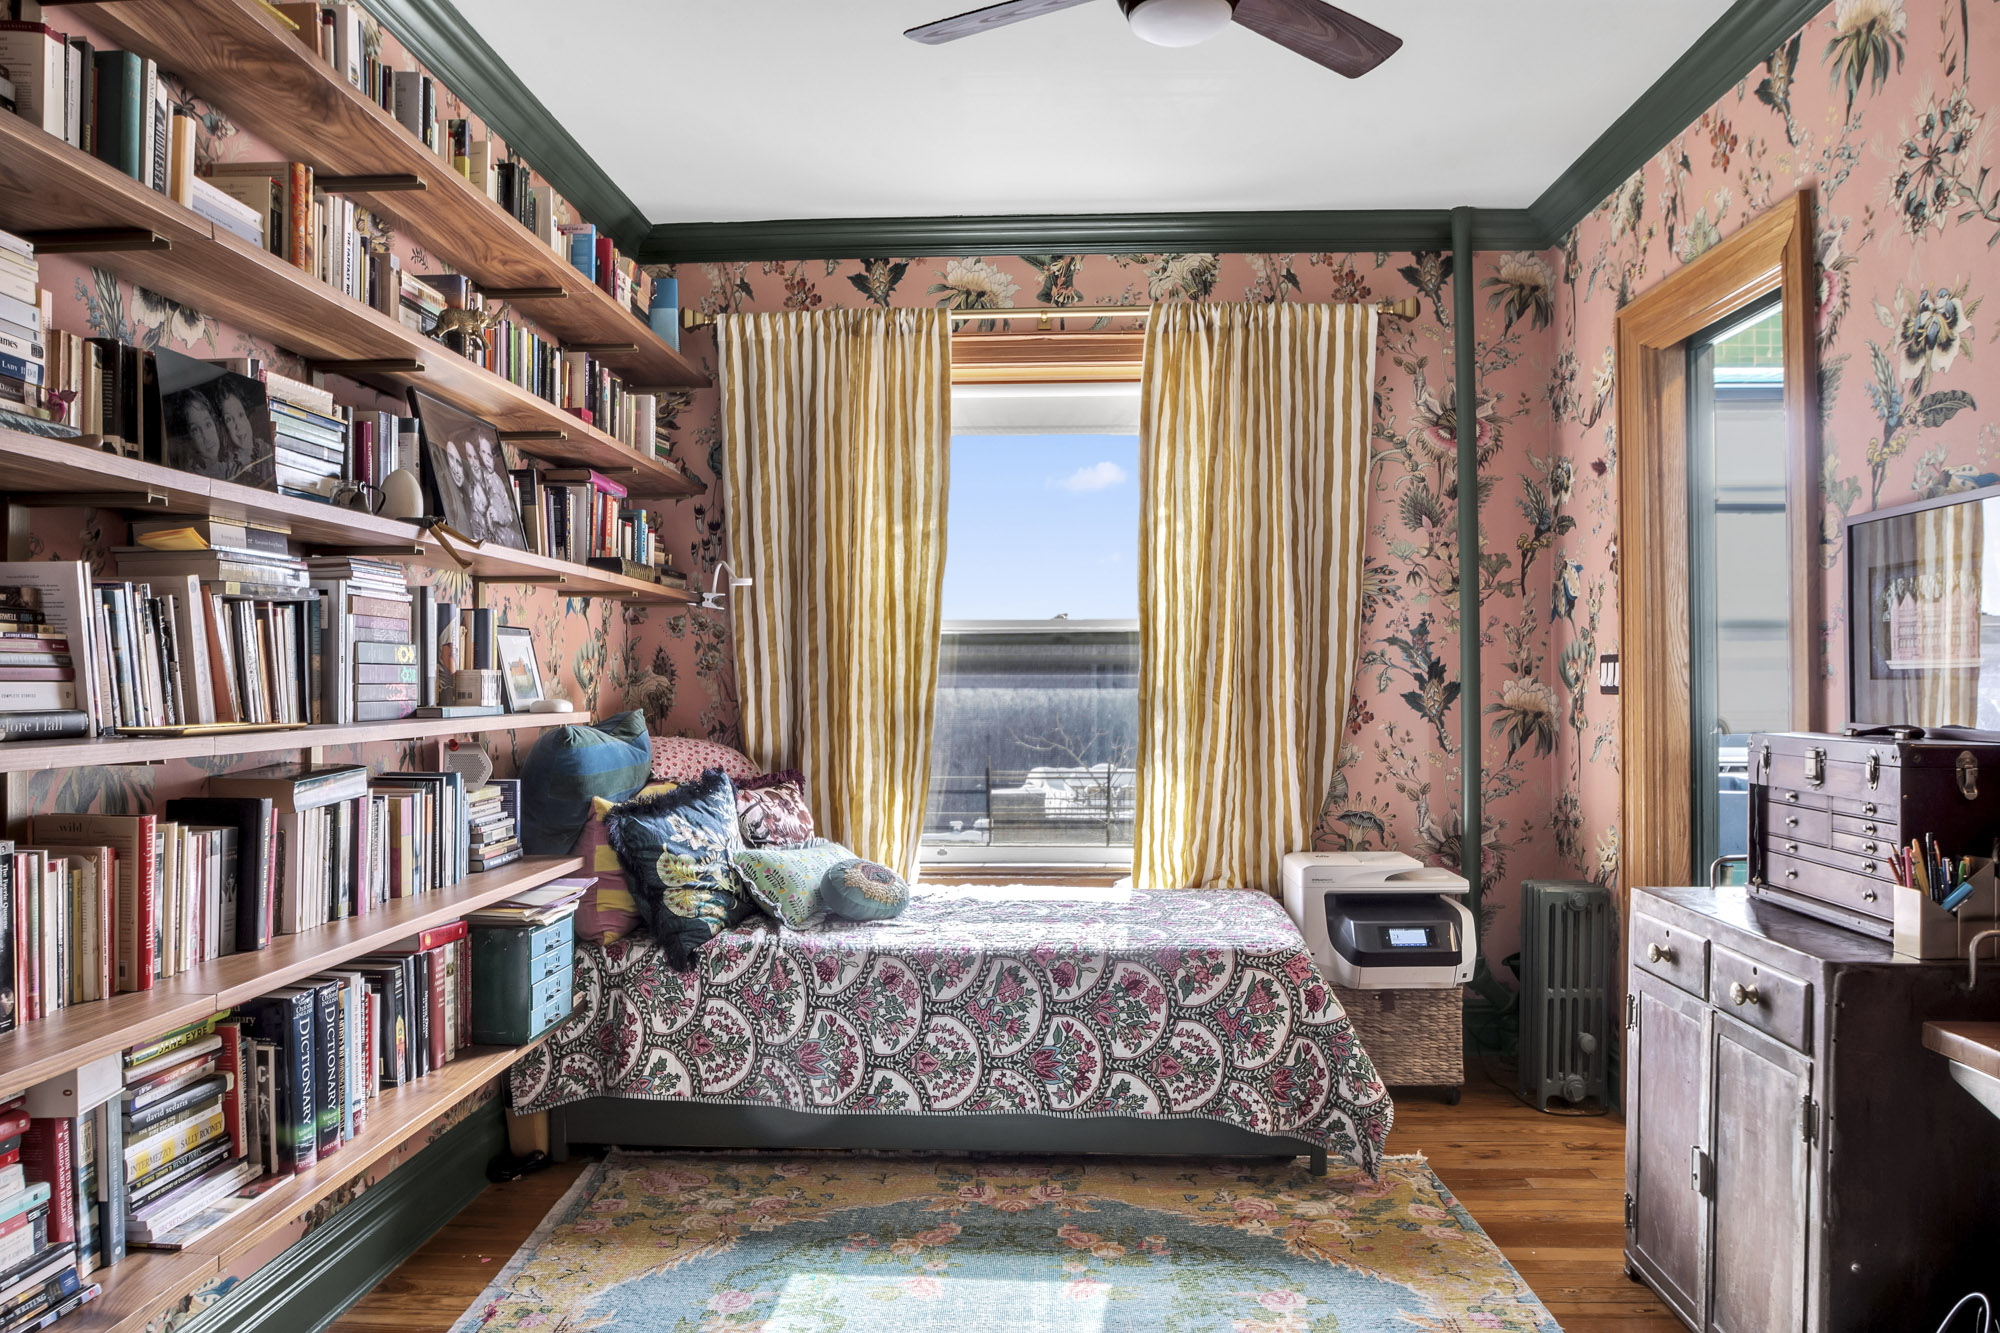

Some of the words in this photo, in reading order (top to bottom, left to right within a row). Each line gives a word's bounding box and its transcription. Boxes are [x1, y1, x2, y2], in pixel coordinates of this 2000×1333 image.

[154, 122, 165, 187] MIDDLESEX
[0, 337, 18, 349] ames
[0, 613, 16, 621] RWELL
[193, 624, 207, 685] PLATO
[0, 719, 31, 733] efore
[44, 716, 62, 731] fall
[58, 822, 82, 832] wild
[143, 823, 154, 863] Cheryl
[143, 867, 154, 911] Strayed
[159, 1036, 182, 1053] JANE
[185, 1025, 208, 1041] EYRE
[299, 1018, 311, 1125] DICTIONARY
[325, 1005, 336, 1110] DICTIONARY
[146, 1107, 164, 1123] david
[166, 1098, 188, 1114] sedaris
[63, 1132, 72, 1170] INVITATION
[130, 1146, 172, 1176] INTERMEZZO
[181, 1130, 198, 1149] SALLY
[200, 1118, 223, 1140] ROONEY
[172, 1157, 188, 1169] HENRY
[188, 1150, 201, 1161] JAMES
[15, 1293, 47, 1316] WRITING
